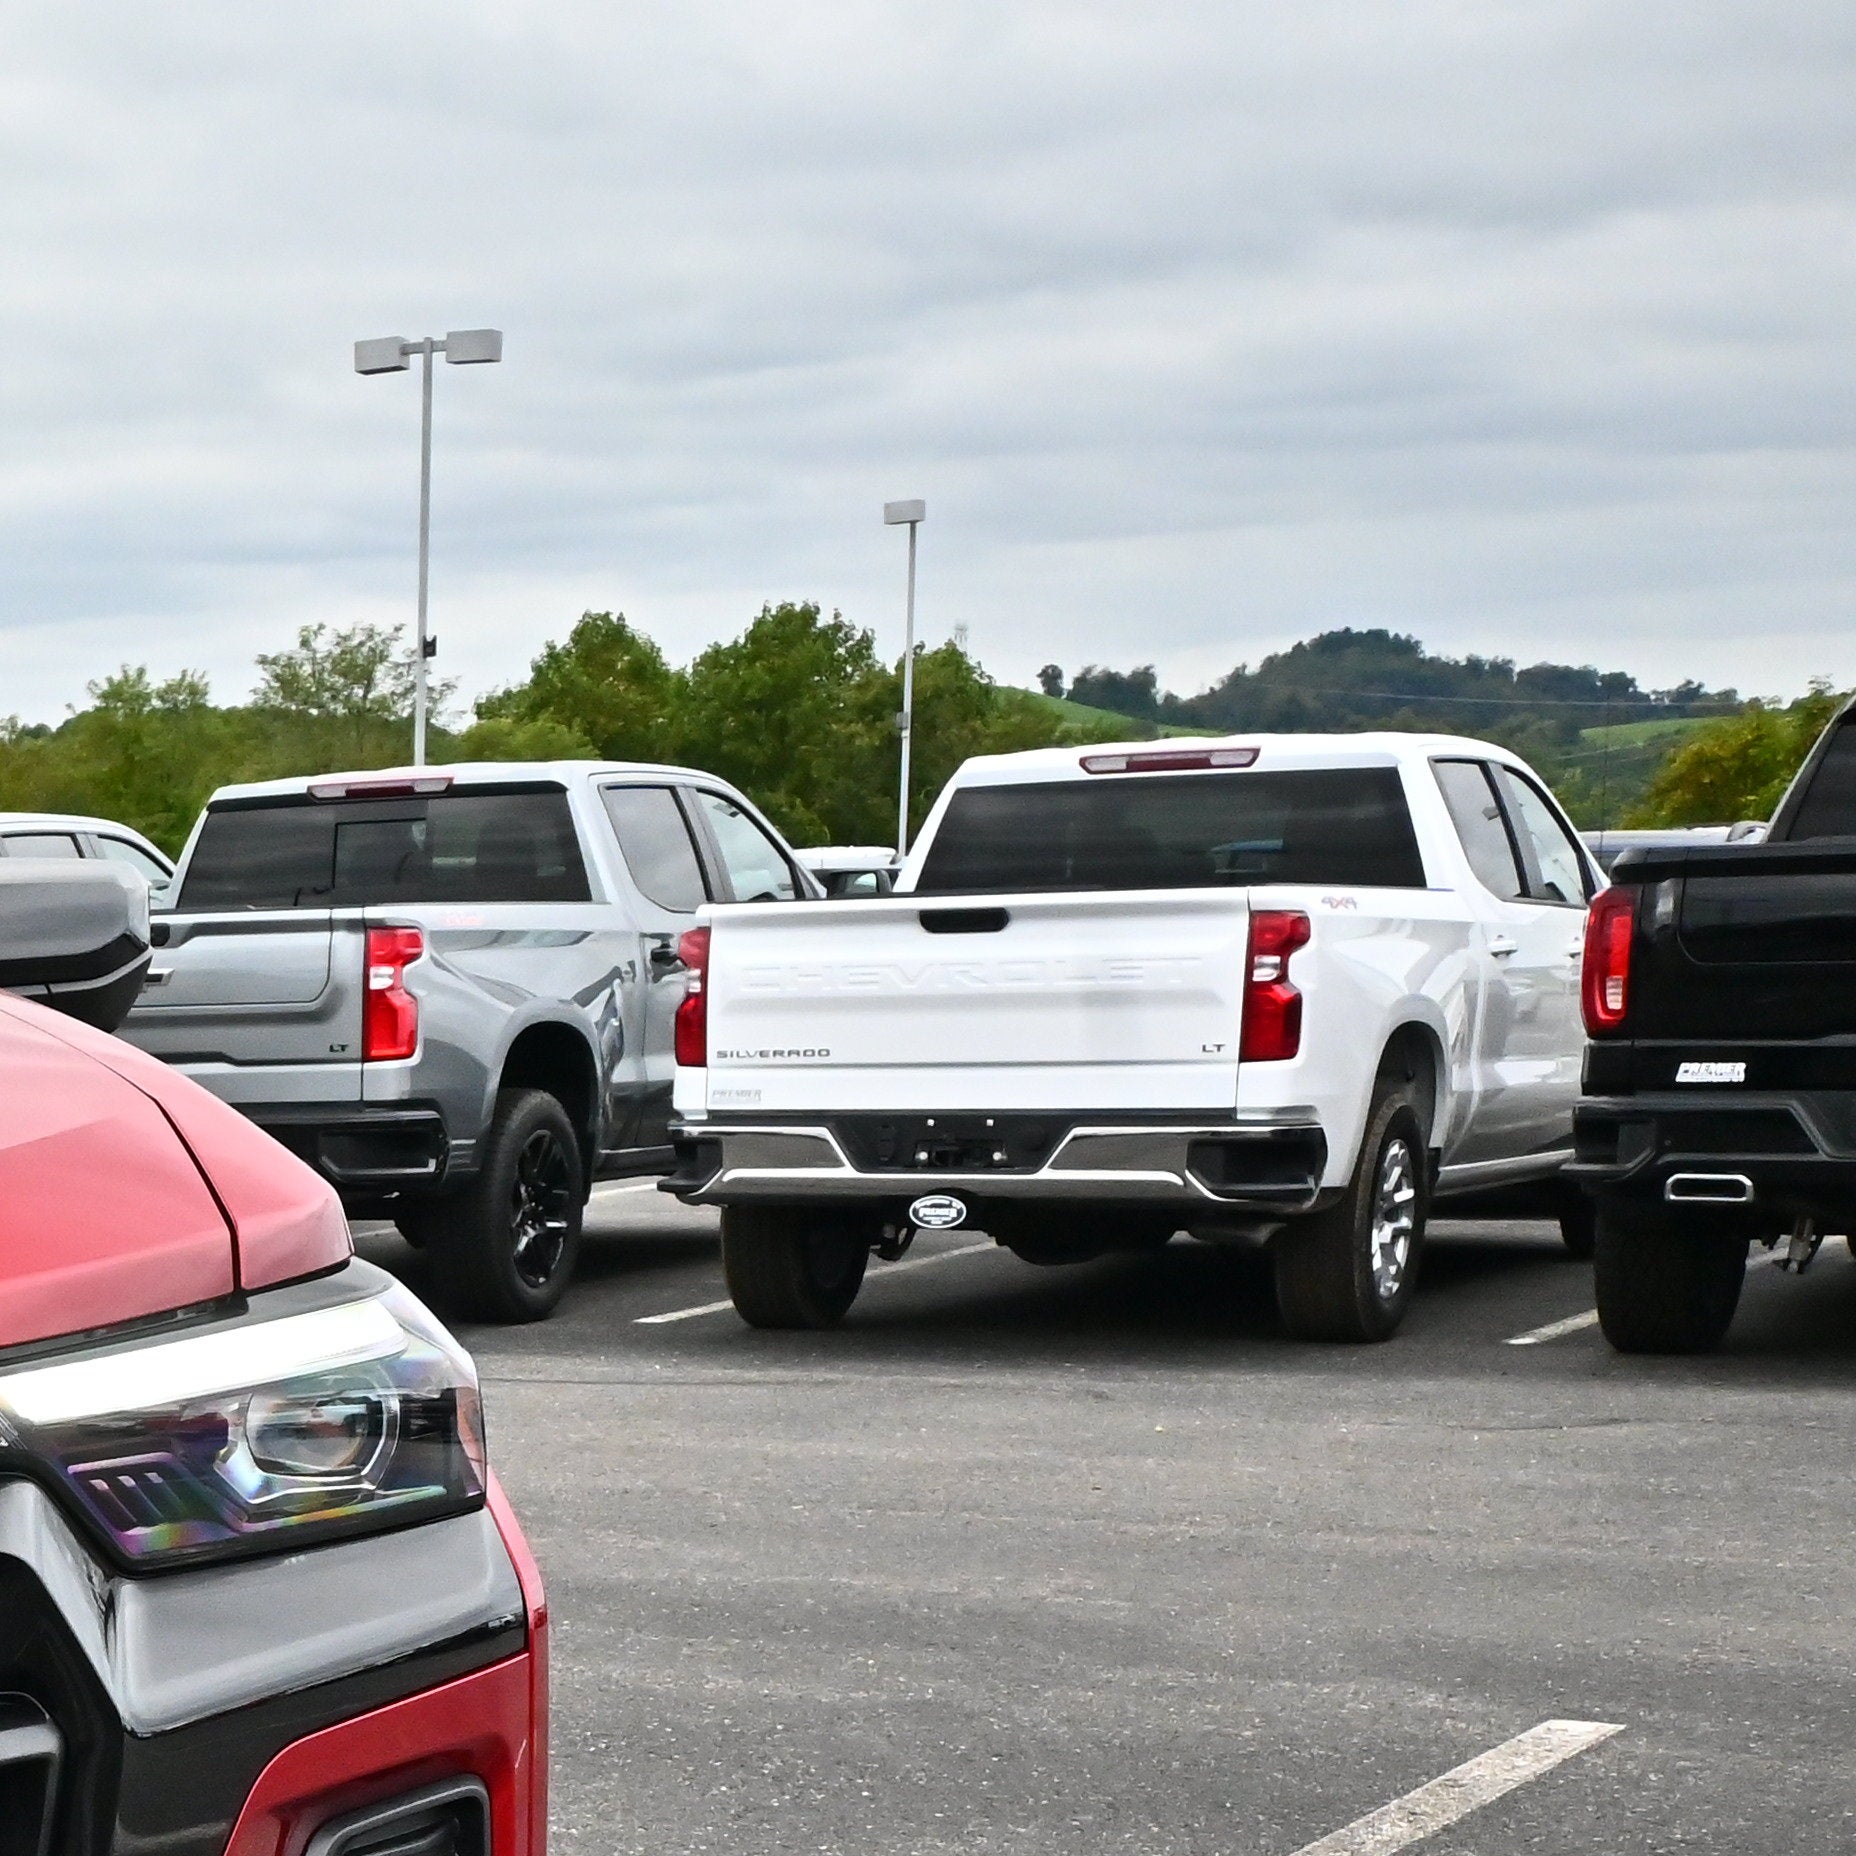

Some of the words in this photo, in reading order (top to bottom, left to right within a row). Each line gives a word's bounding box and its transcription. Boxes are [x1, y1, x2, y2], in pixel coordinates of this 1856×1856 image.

[740, 956, 1204, 992] CHEVROLET
[329, 1044, 349, 1052] LT
[1202, 1044, 1226, 1053] LT
[716, 1048, 830, 1059] SILVERADO
